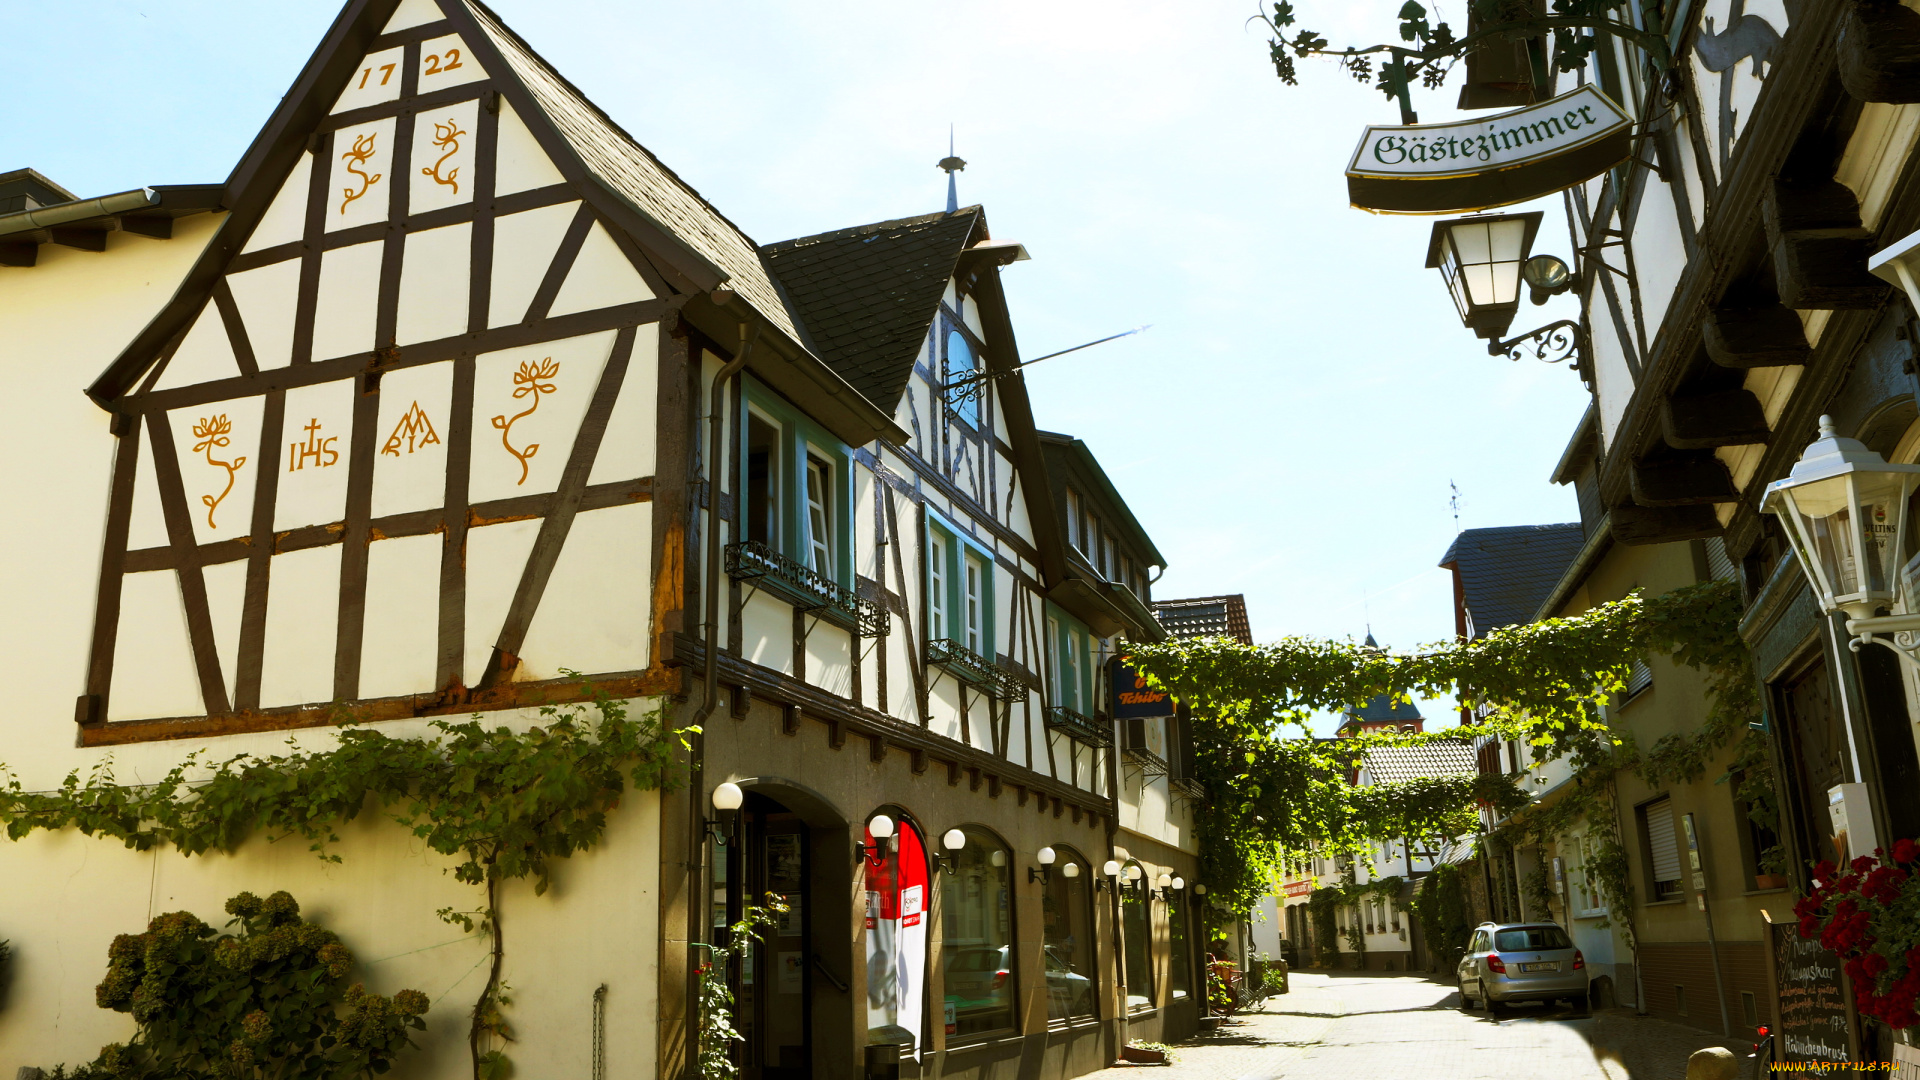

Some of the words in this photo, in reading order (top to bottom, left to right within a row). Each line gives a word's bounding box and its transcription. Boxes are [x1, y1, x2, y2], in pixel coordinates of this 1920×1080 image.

[1373, 103, 1597, 164] Gästezimmer
[1118, 691, 1168, 705] Tchibo
[1784, 1034, 1849, 1063] Hähnchenbrust
